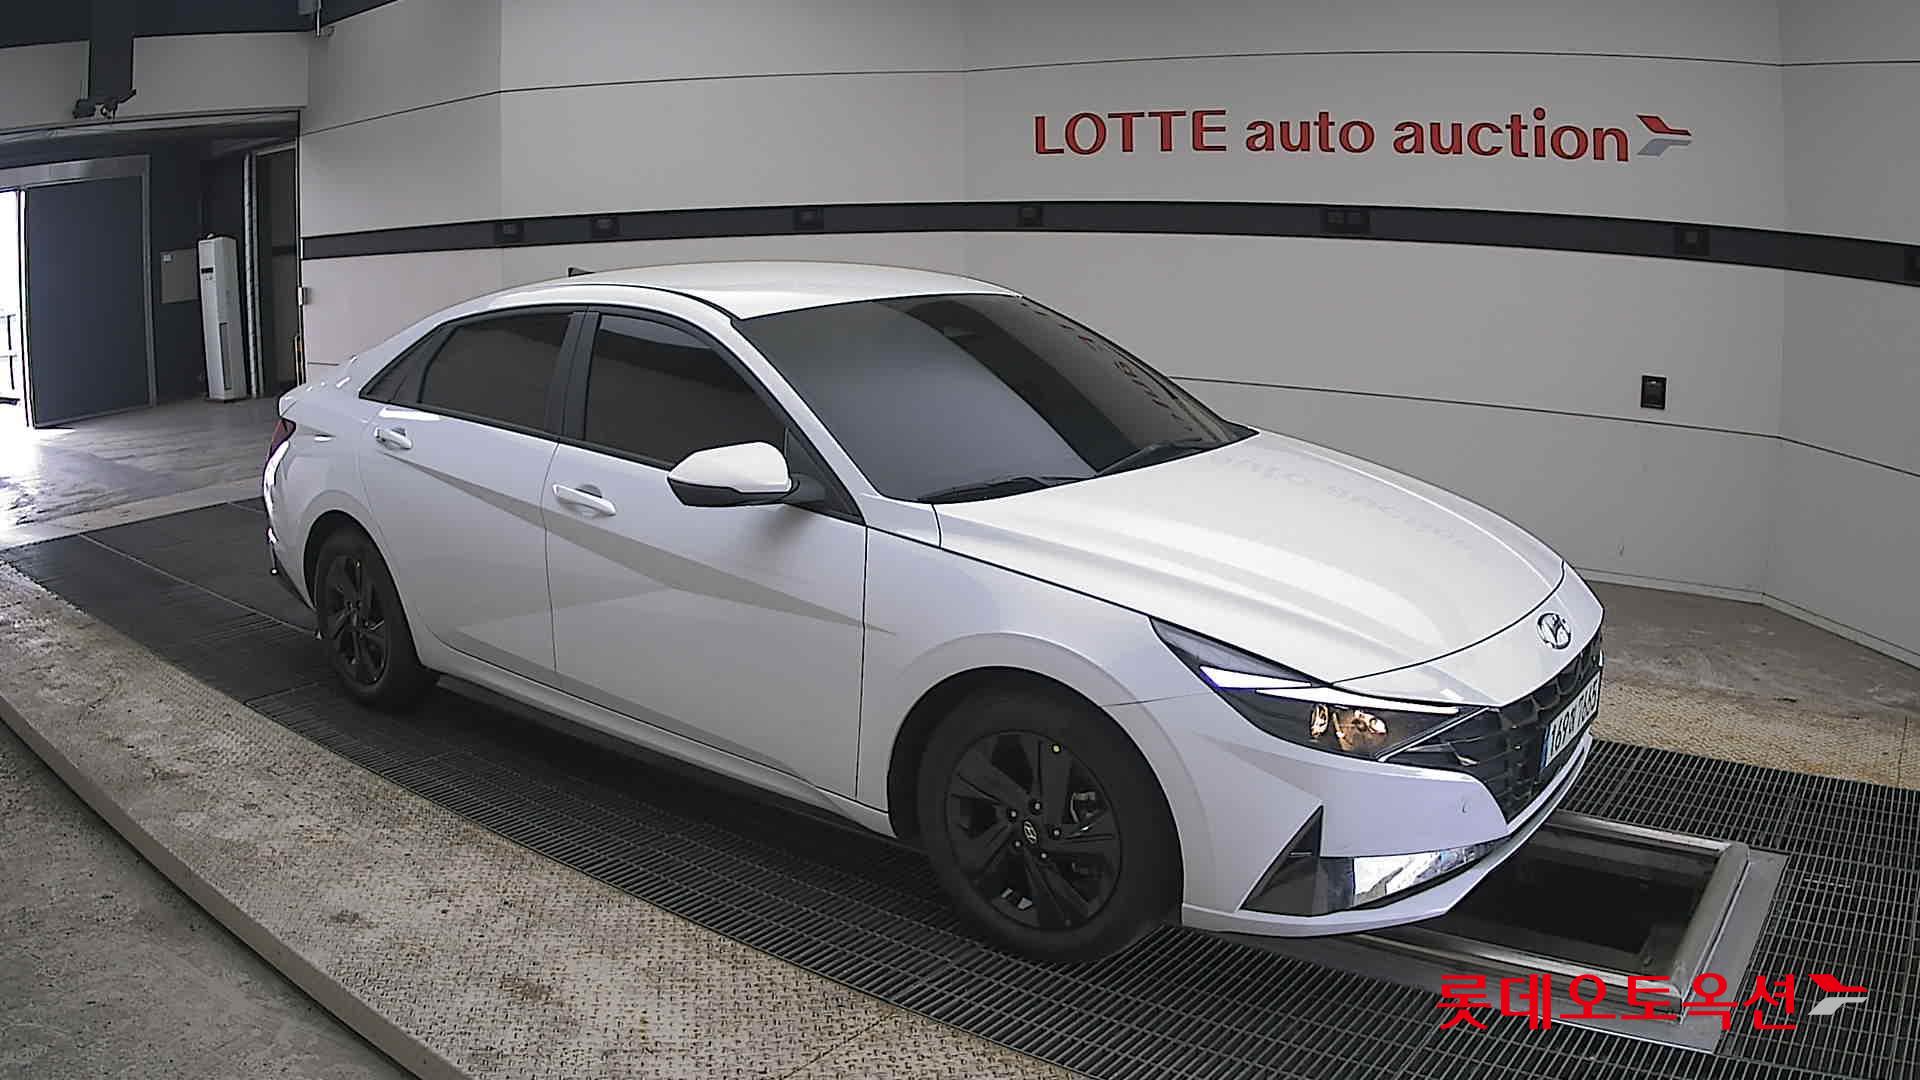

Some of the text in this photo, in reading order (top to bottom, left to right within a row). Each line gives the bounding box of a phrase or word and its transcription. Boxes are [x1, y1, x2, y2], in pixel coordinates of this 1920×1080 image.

[1035, 108, 1629, 161] LOTTE auto auction
